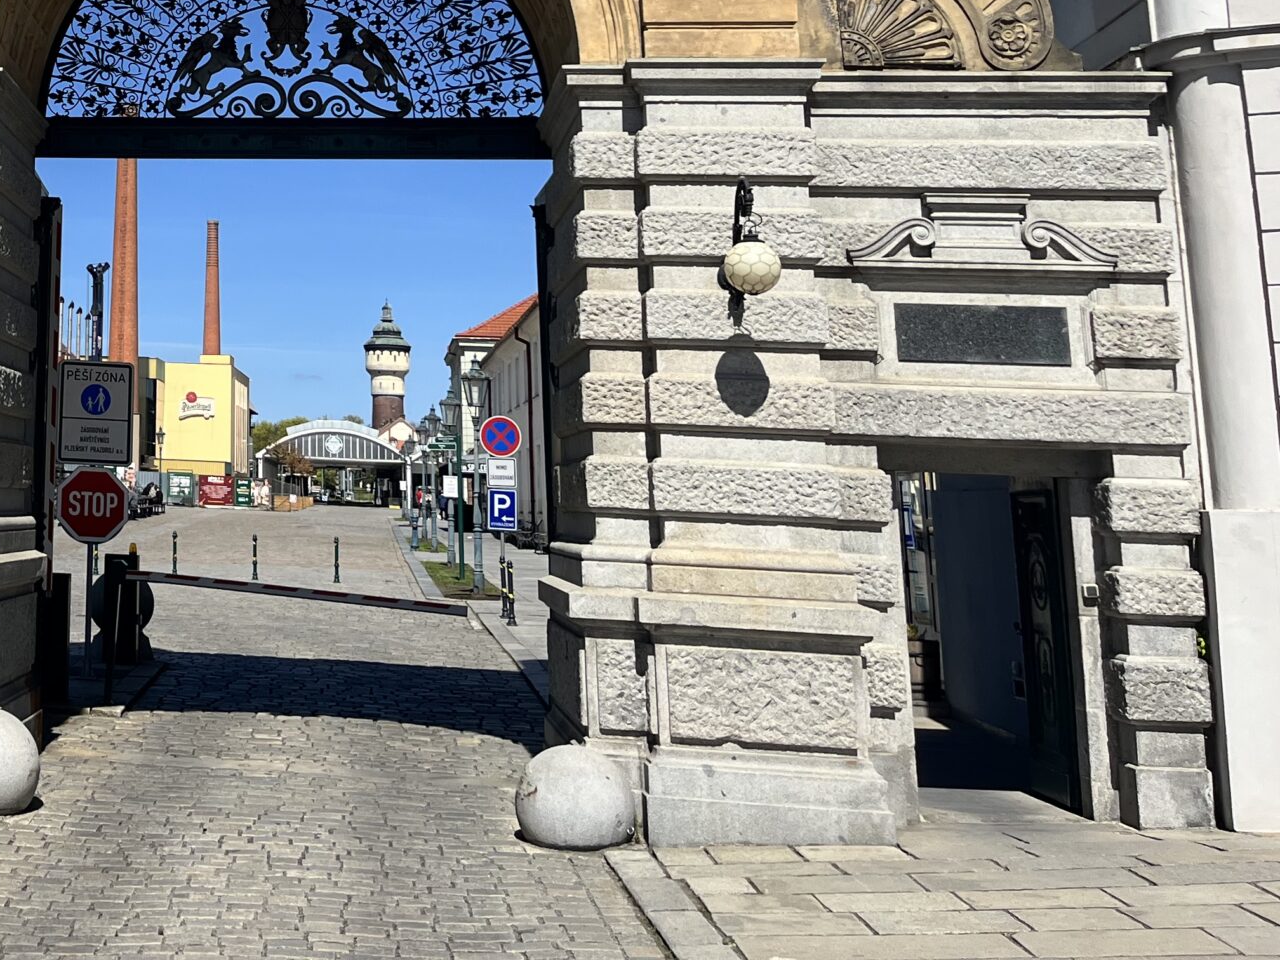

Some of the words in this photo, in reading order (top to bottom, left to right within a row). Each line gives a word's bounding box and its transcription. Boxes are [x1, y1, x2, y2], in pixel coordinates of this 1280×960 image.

[66, 368, 93, 382] PĚŠÍ
[95, 369, 126, 383] ZÓNA
[68, 491, 118, 517] STOP
[494, 494, 511, 517] P
